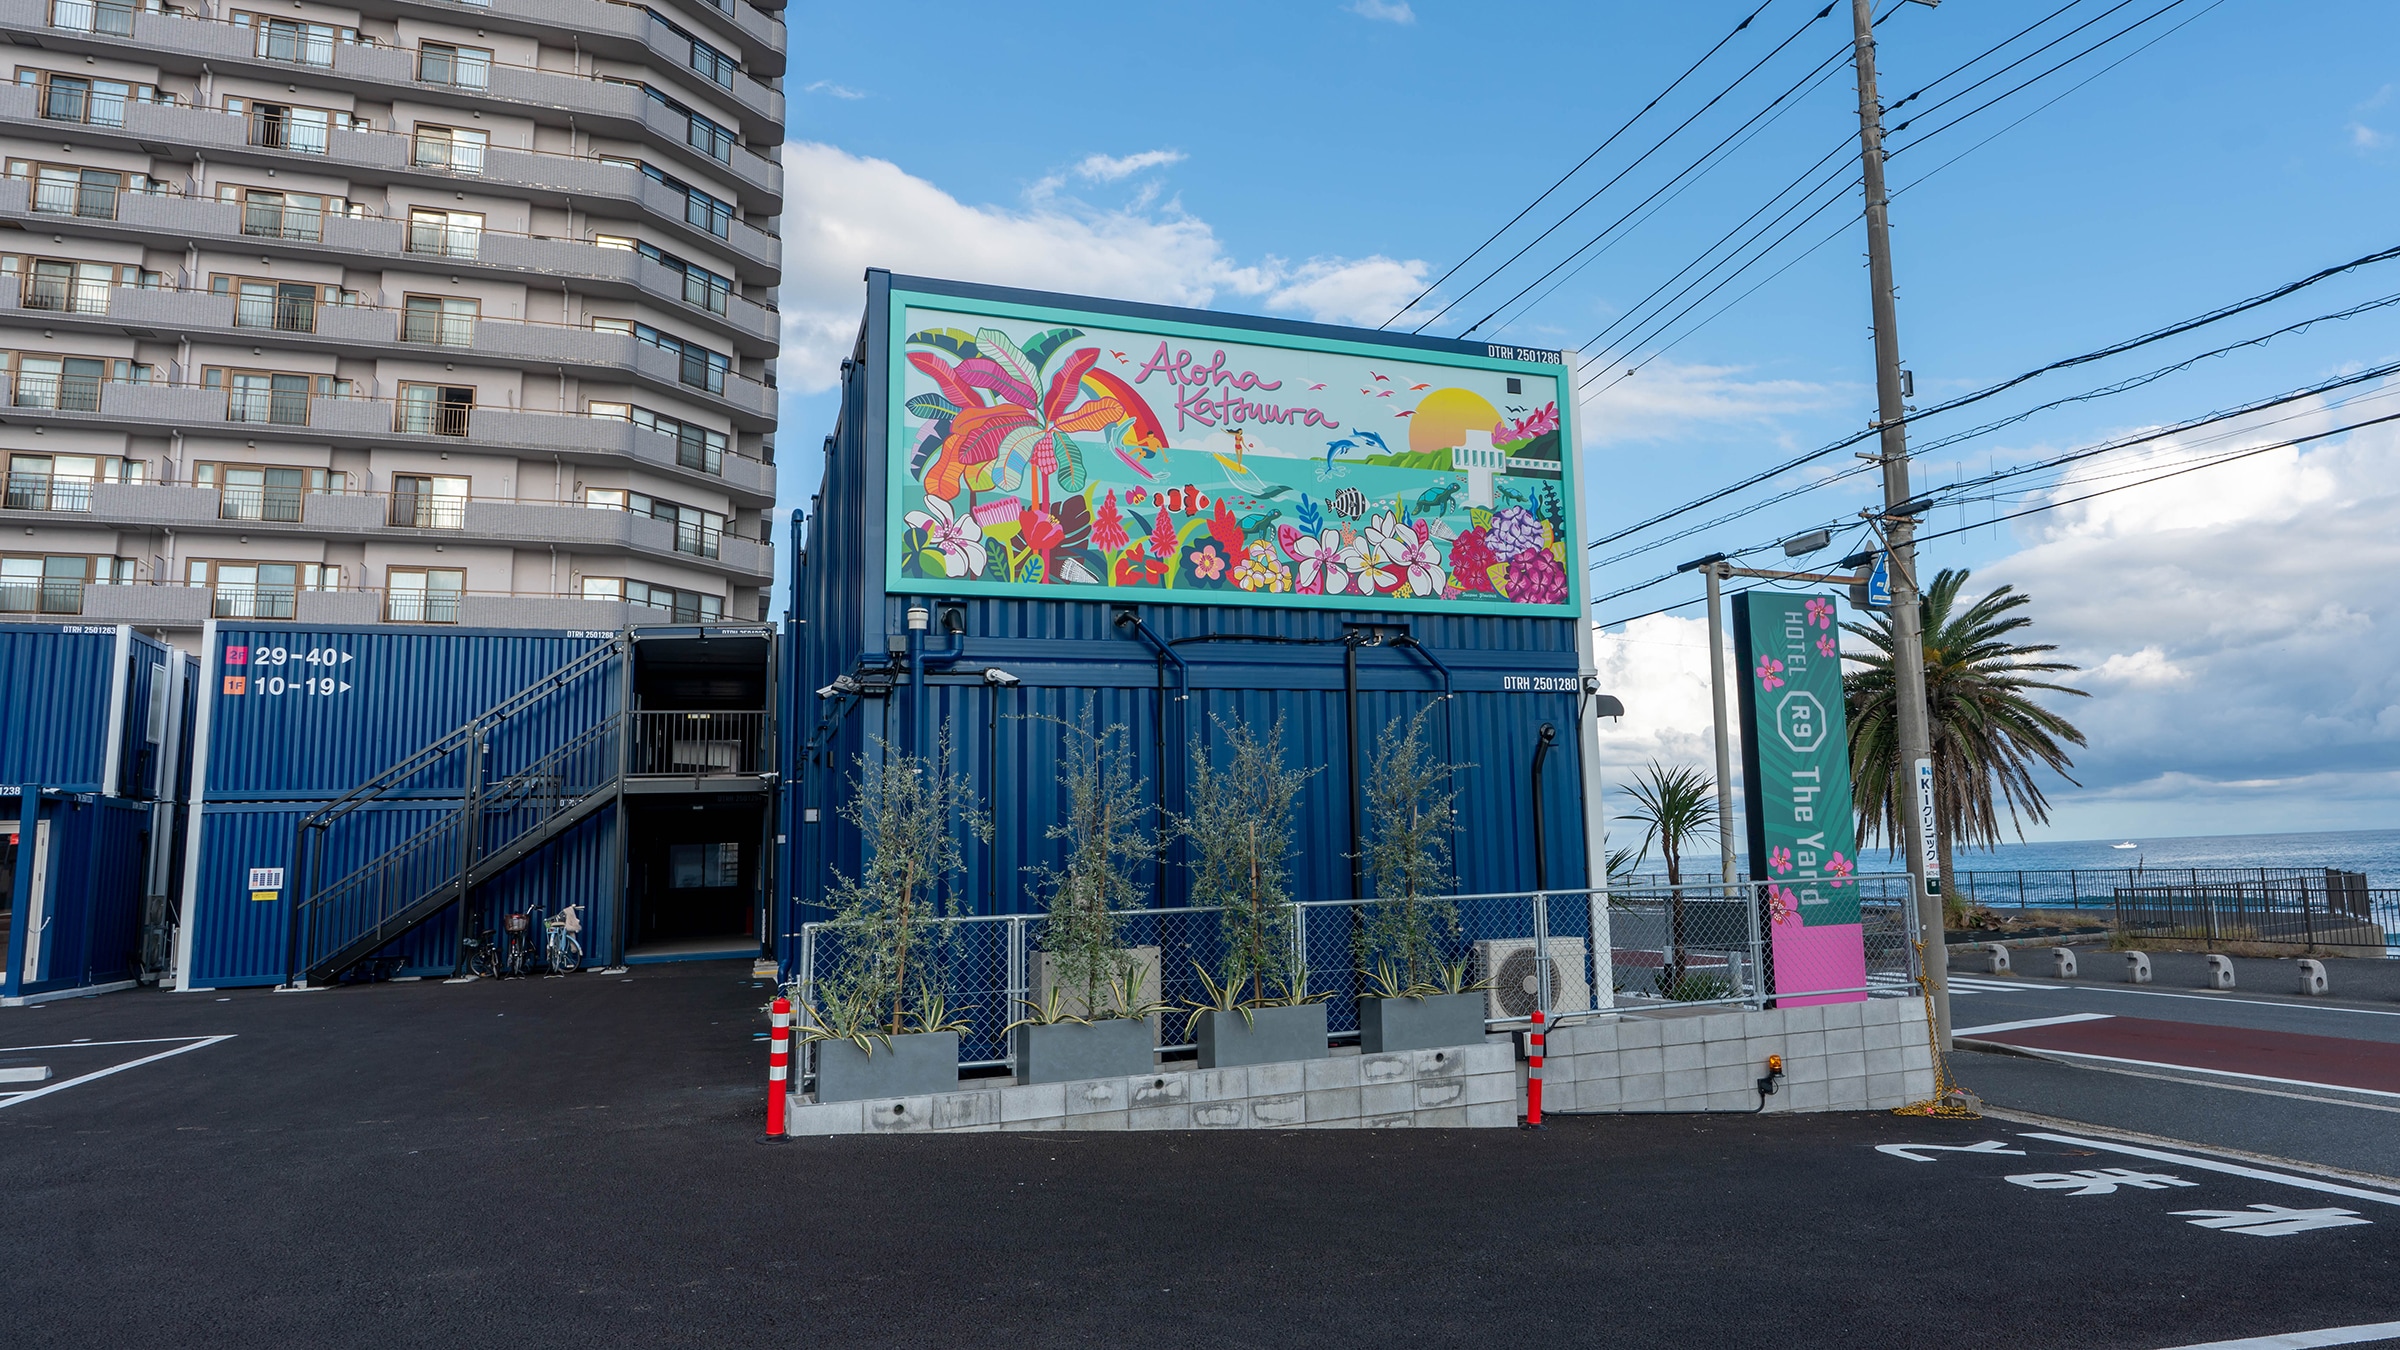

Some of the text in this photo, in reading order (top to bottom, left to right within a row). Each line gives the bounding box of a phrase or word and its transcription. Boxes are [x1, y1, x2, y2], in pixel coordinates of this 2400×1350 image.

[1487, 344, 1561, 366] DTRH 2501286
[1135, 341, 1282, 391] Aloha
[1174, 386, 1339, 432] Katsuura
[62, 626, 82, 635] DTRH
[567, 630, 584, 639] DTRH
[229, 646, 338, 667] 2F 29-40
[228, 676, 336, 696] 1F 10-19
[1503, 676, 1578, 691] DTRH 2501280
[1784, 611, 1829, 906] HOTEL R9 The Yard
